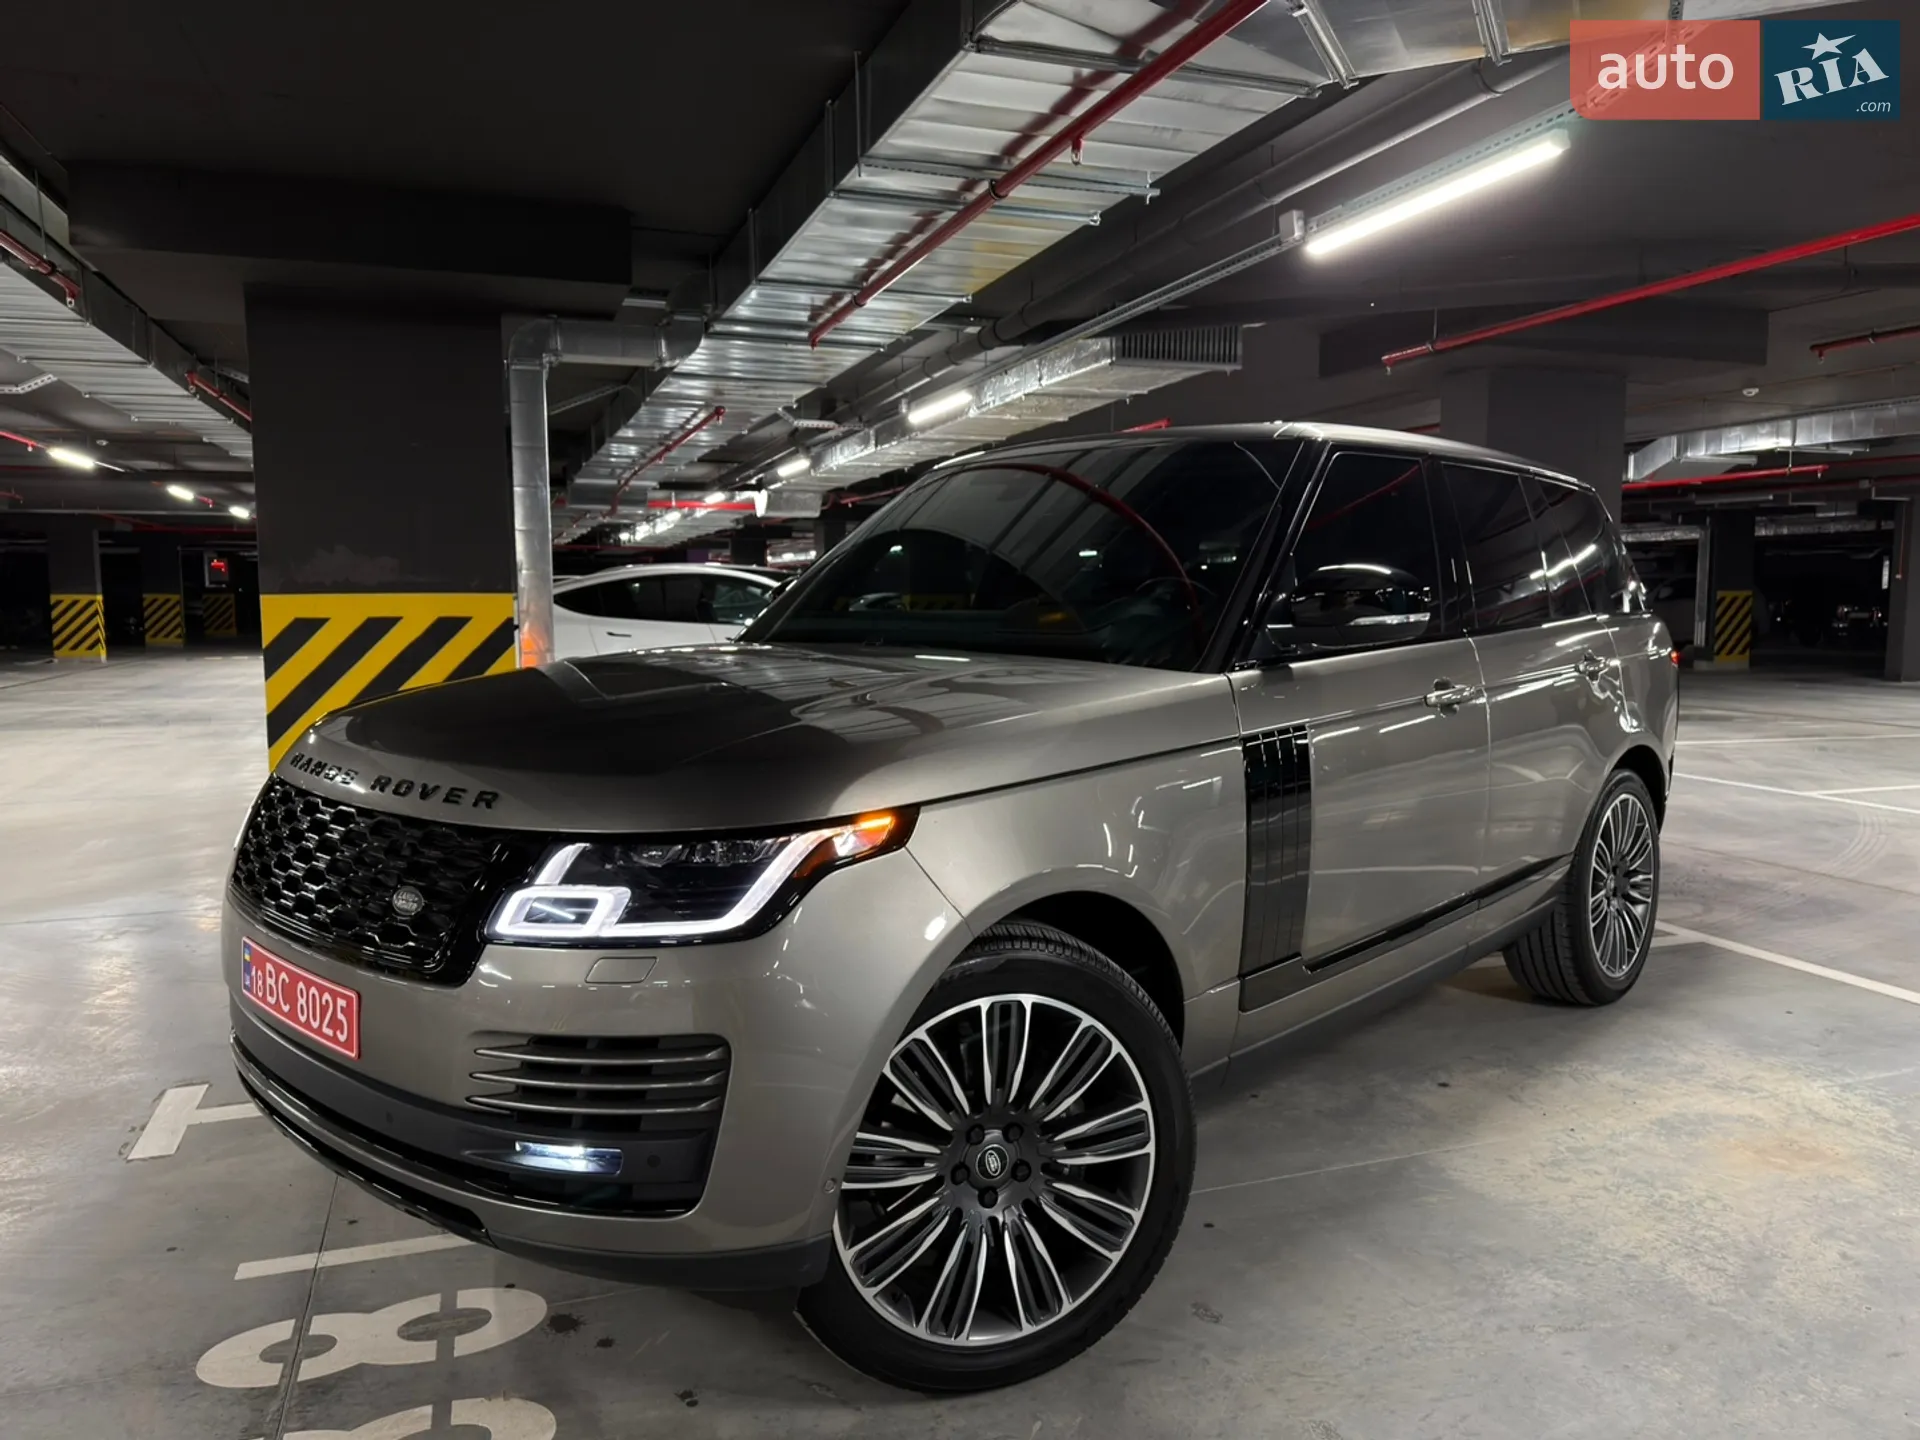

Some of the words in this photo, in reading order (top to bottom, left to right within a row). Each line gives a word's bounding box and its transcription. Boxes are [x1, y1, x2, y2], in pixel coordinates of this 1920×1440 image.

[290, 752, 359, 785] RANGE
[369, 774, 499, 810] ROVER
[250, 965, 264, 998] 18
[265, 961, 291, 1014] BC
[296, 980, 349, 1043] 8025
